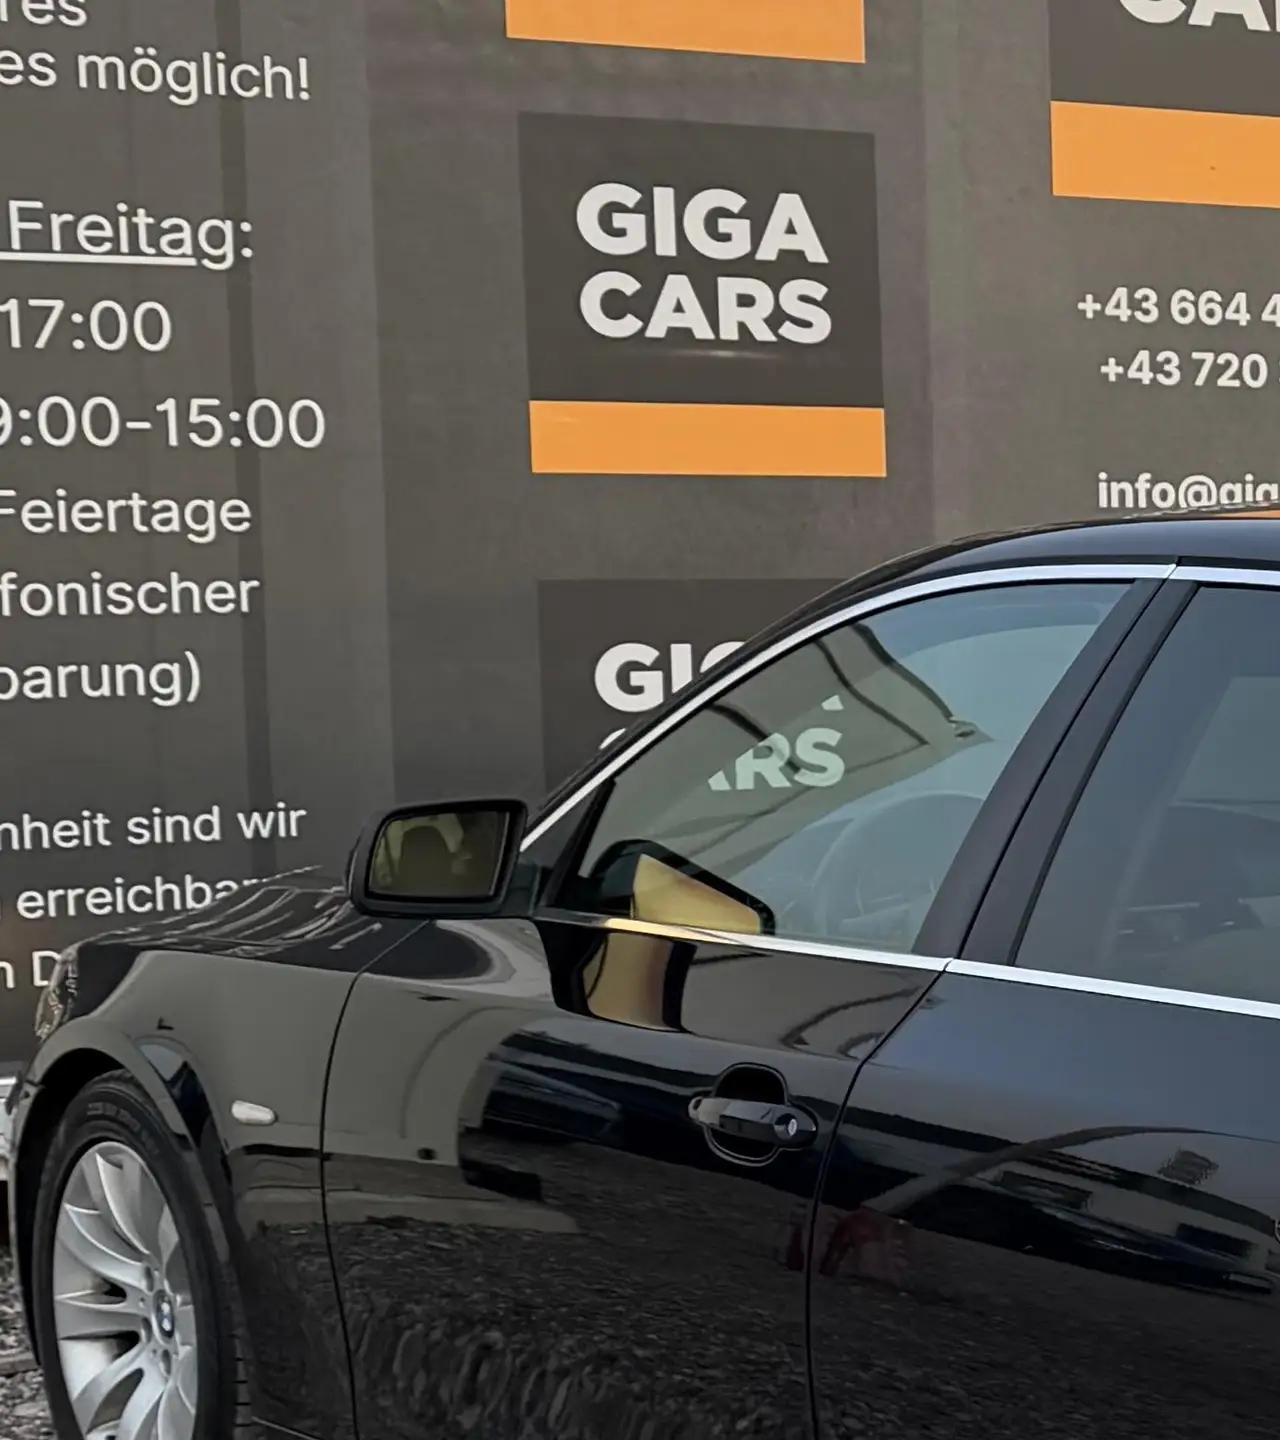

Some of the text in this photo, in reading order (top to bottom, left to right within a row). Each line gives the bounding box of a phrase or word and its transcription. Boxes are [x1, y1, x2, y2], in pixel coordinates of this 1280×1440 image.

[78, 46, 310, 105] möglich!
[8, 200, 253, 270] Freitag:
[576, 183, 829, 264] GIGA
[0, 299, 172, 352] 17:00
[580, 271, 832, 344] CARS
[1077, 287, 1159, 323] +43
[1170, 289, 1251, 326] 664
[1100, 349, 1181, 386] +43
[1192, 351, 1268, 388] 720
[0, 571, 260, 617] fonischer
[127, 805, 221, 845] sind
[237, 802, 307, 839] wir
[16, 874, 259, 920] erreichba
